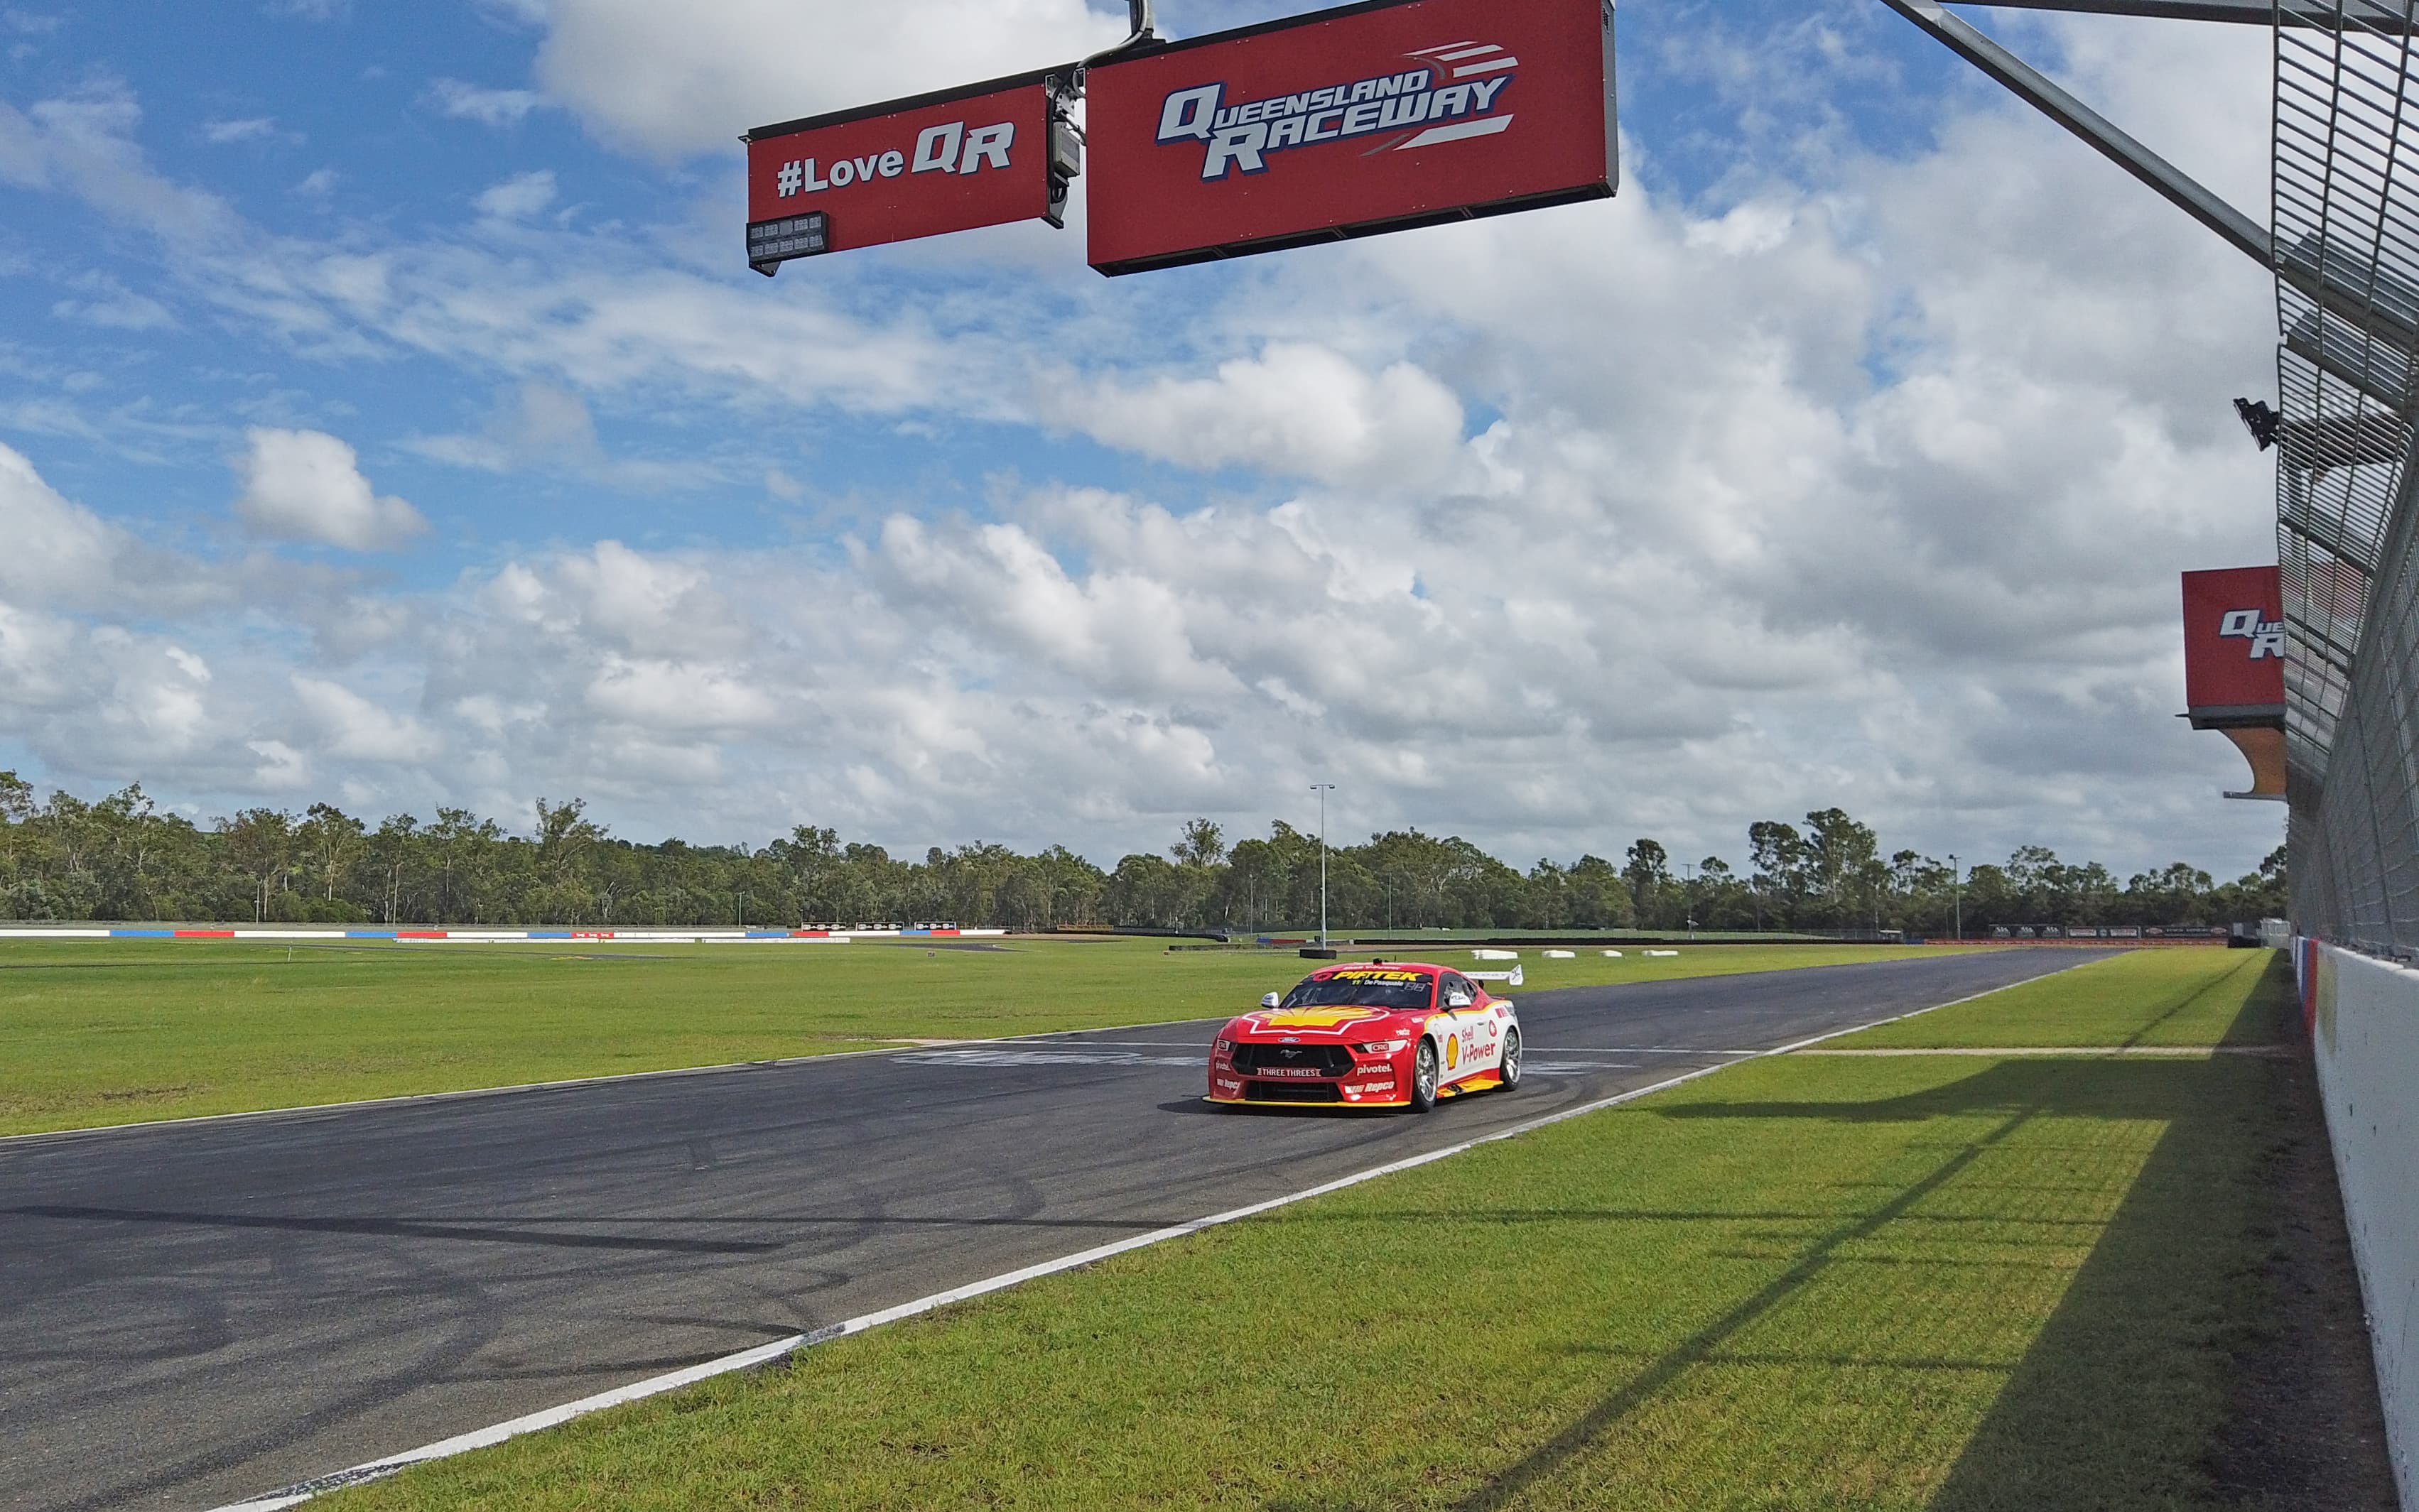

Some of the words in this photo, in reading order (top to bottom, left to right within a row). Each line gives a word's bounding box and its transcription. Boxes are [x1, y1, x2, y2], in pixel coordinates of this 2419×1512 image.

[1158, 69, 1429, 139] QUEENSLAND
[1201, 77, 1508, 178] RACEWAY
[777, 150, 904, 197] #Love
[911, 121, 1014, 175] QR
[1461, 1026, 1474, 1043] Shell
[1461, 1043, 1495, 1065] V-Power
[1262, 1068, 1285, 1077] THREE
[1287, 1069, 1316, 1077] THREES
[1365, 1081, 1395, 1093] Repco
